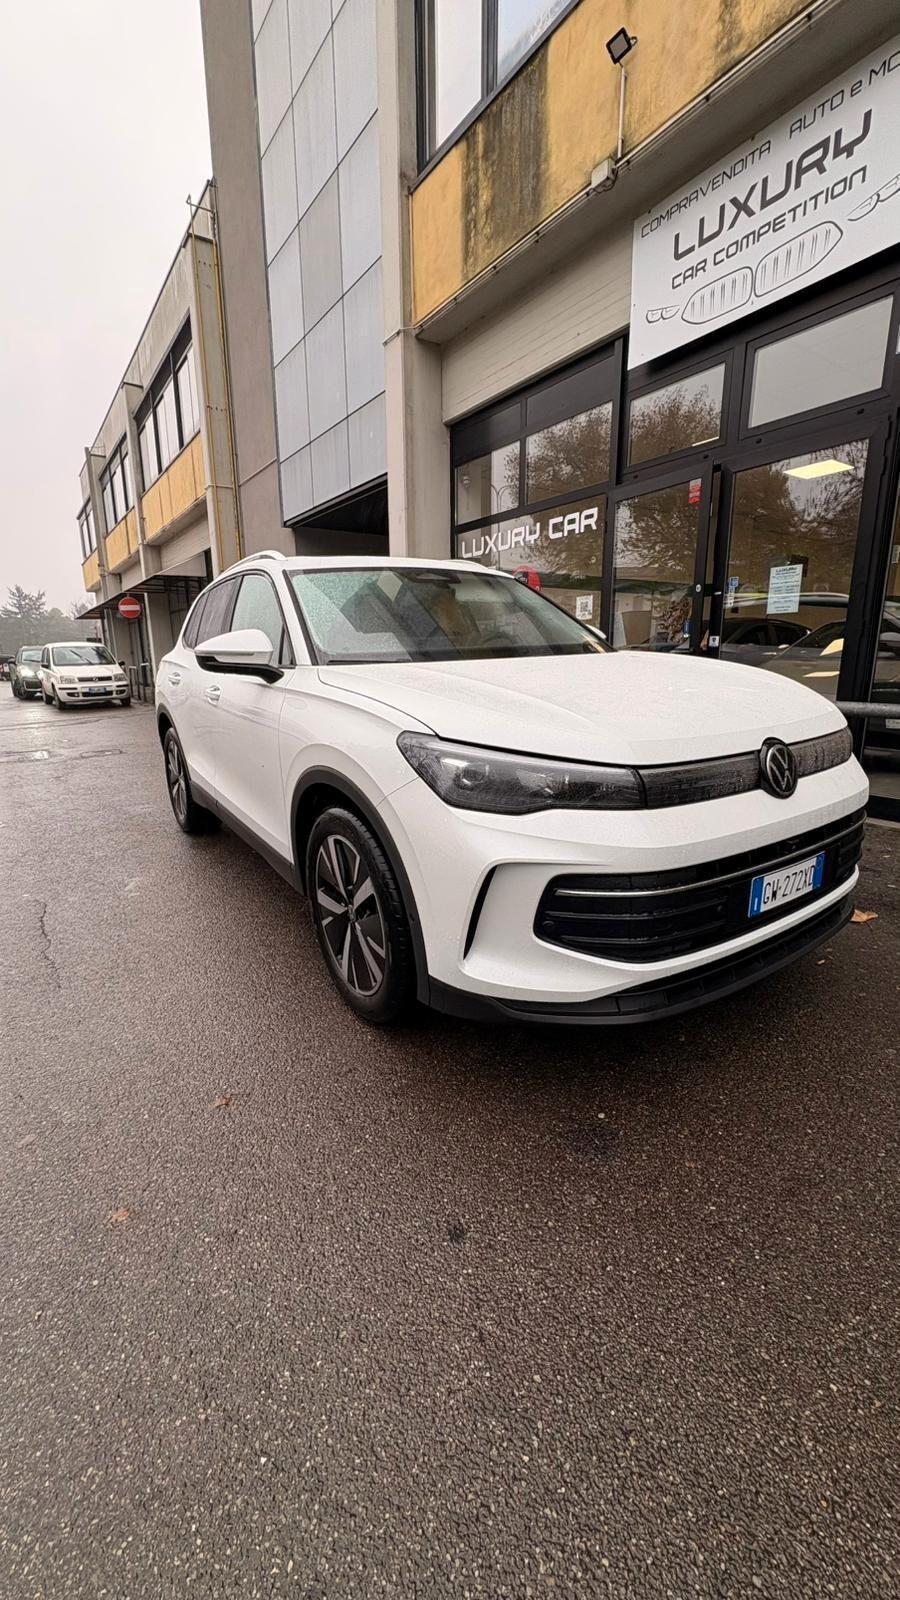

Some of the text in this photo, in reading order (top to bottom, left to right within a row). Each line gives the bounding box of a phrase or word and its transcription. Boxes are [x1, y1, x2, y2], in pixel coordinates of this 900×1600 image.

[641, 140, 771, 238] COMPRAVENDITA
[789, 90, 844, 139] AUTO
[850, 79, 863, 98] e
[671, 165, 867, 290] CAR COMPETITION
[672, 108, 872, 261] LUXURY
[461, 507, 599, 559] LUXURY CAR
